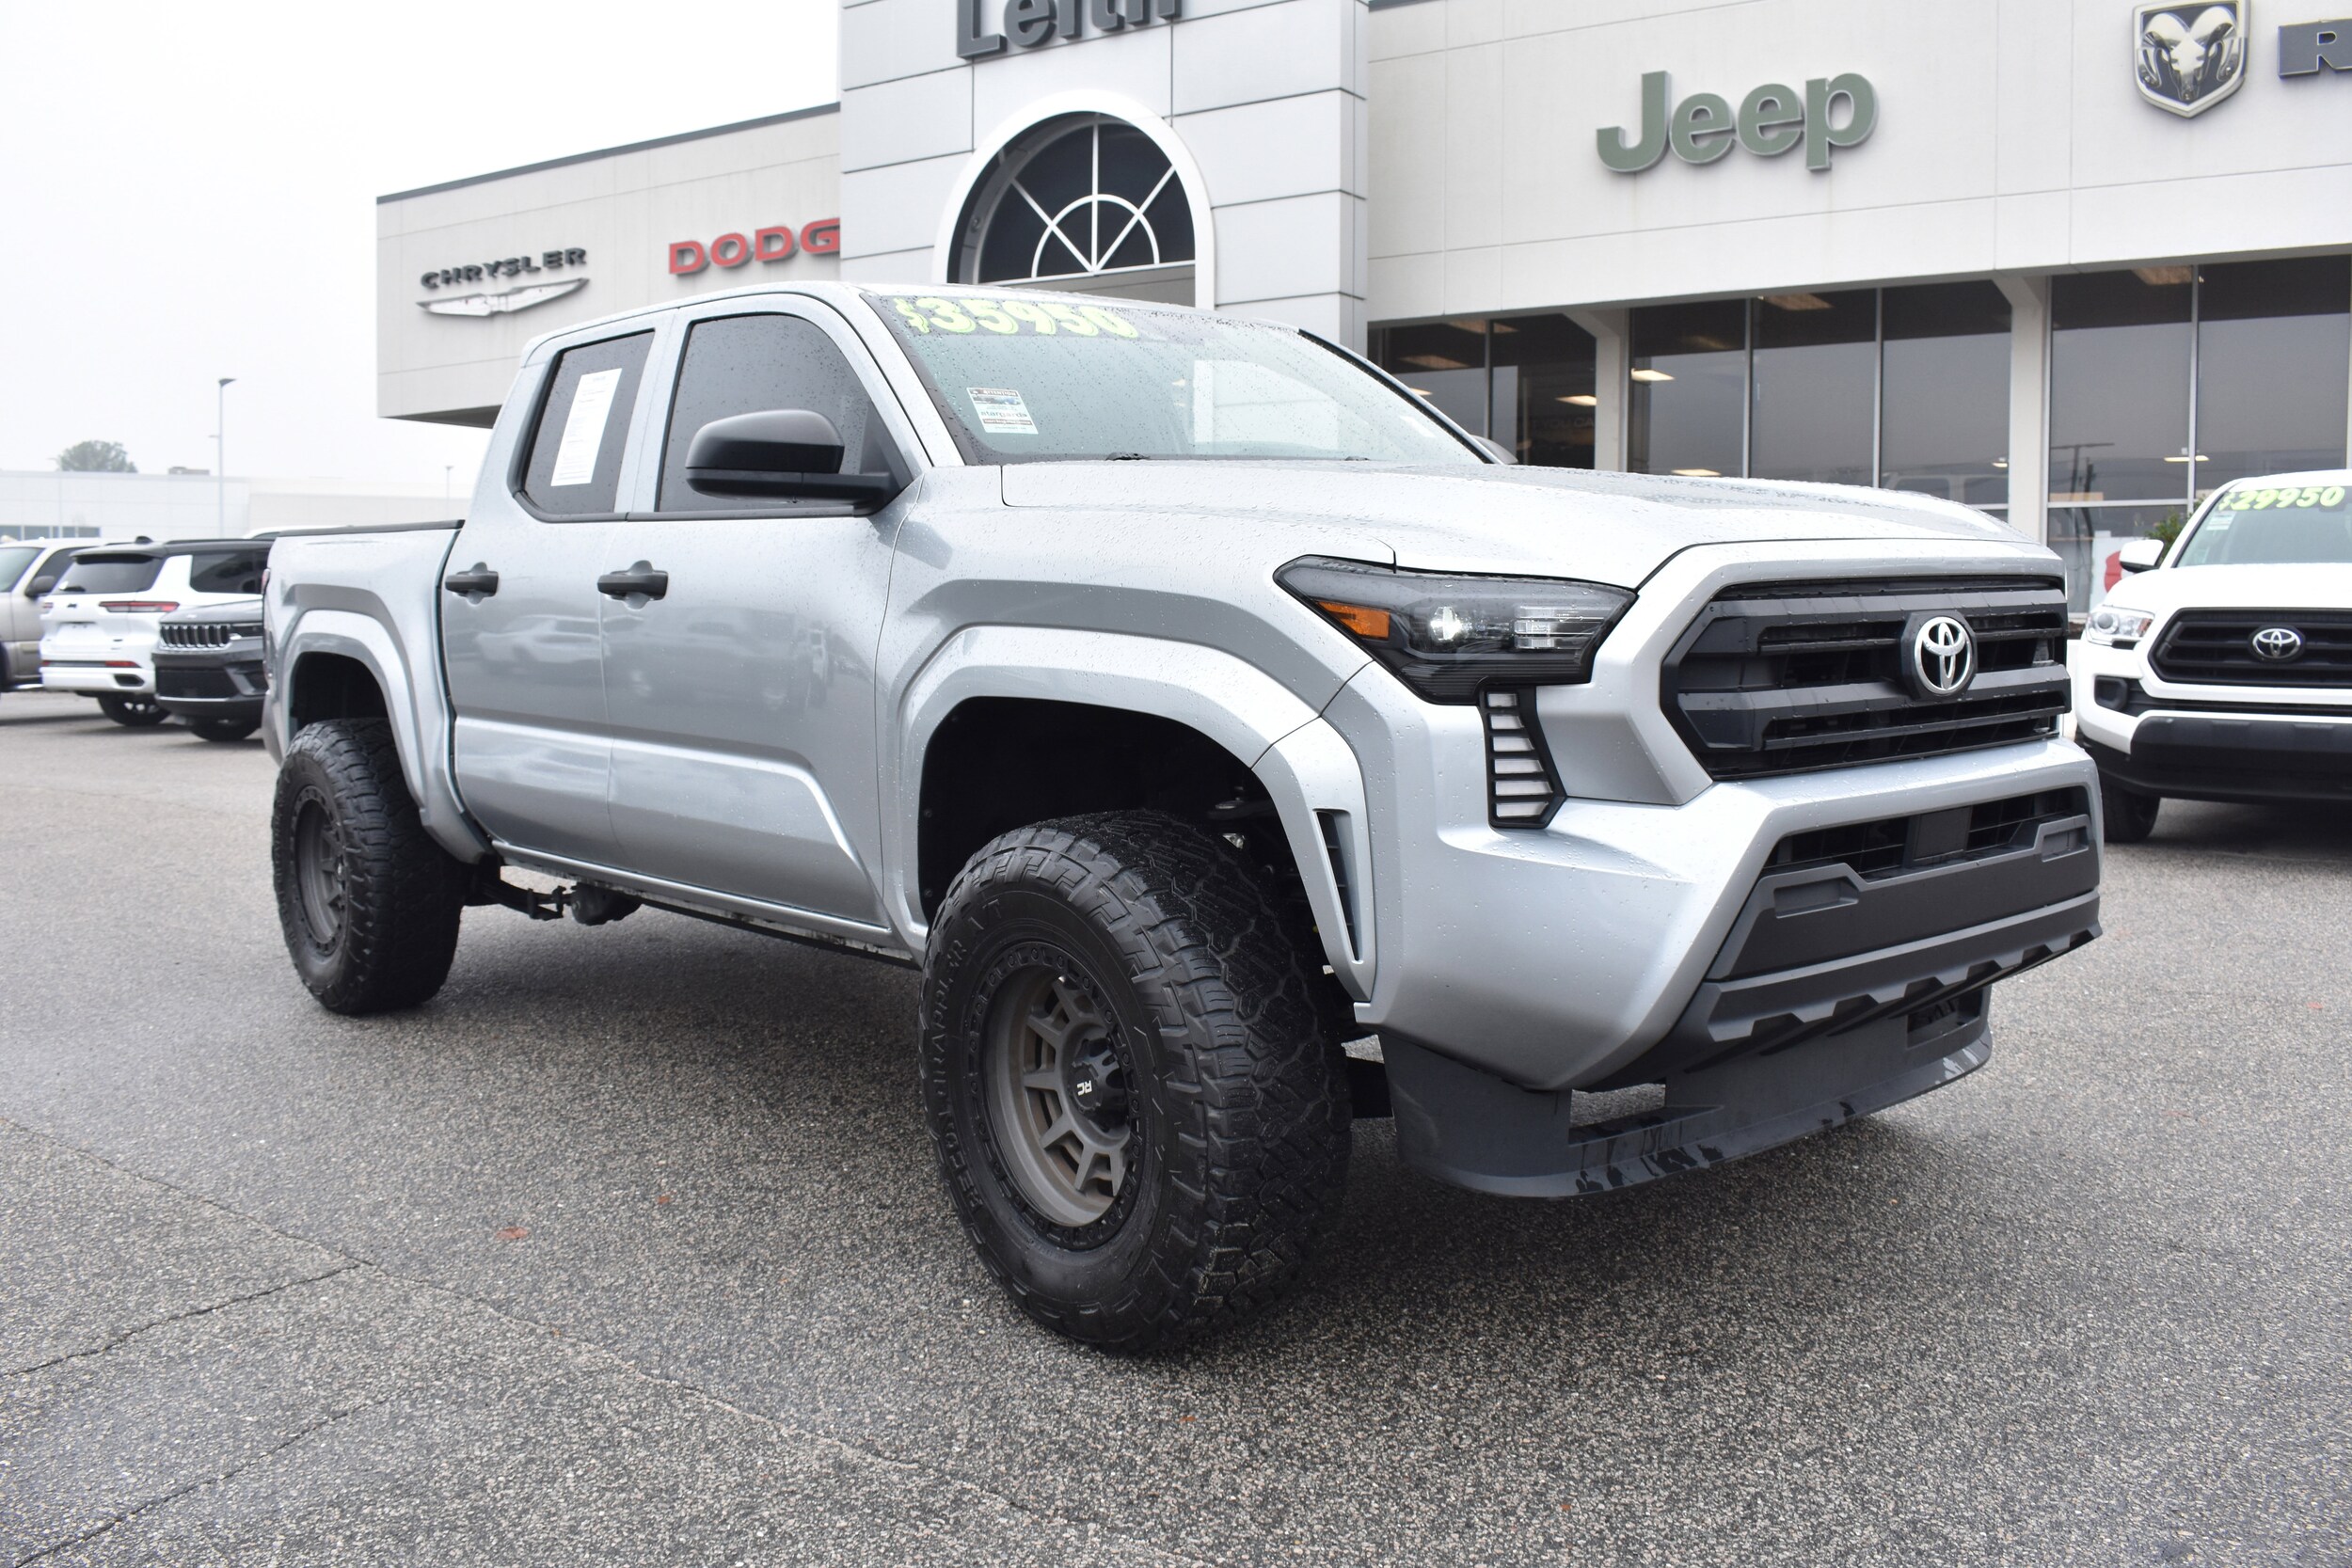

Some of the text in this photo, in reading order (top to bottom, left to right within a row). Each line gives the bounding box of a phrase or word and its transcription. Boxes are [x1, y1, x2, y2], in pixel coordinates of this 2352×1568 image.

[957, 0, 1182, 57] Lei
[1596, 71, 1880, 173] Jeep
[421, 247, 588, 289] CHRYSLER
[669, 217, 841, 276] DODG
[893, 296, 1139, 339] $35950
[2217, 485, 2346, 512] $29950
